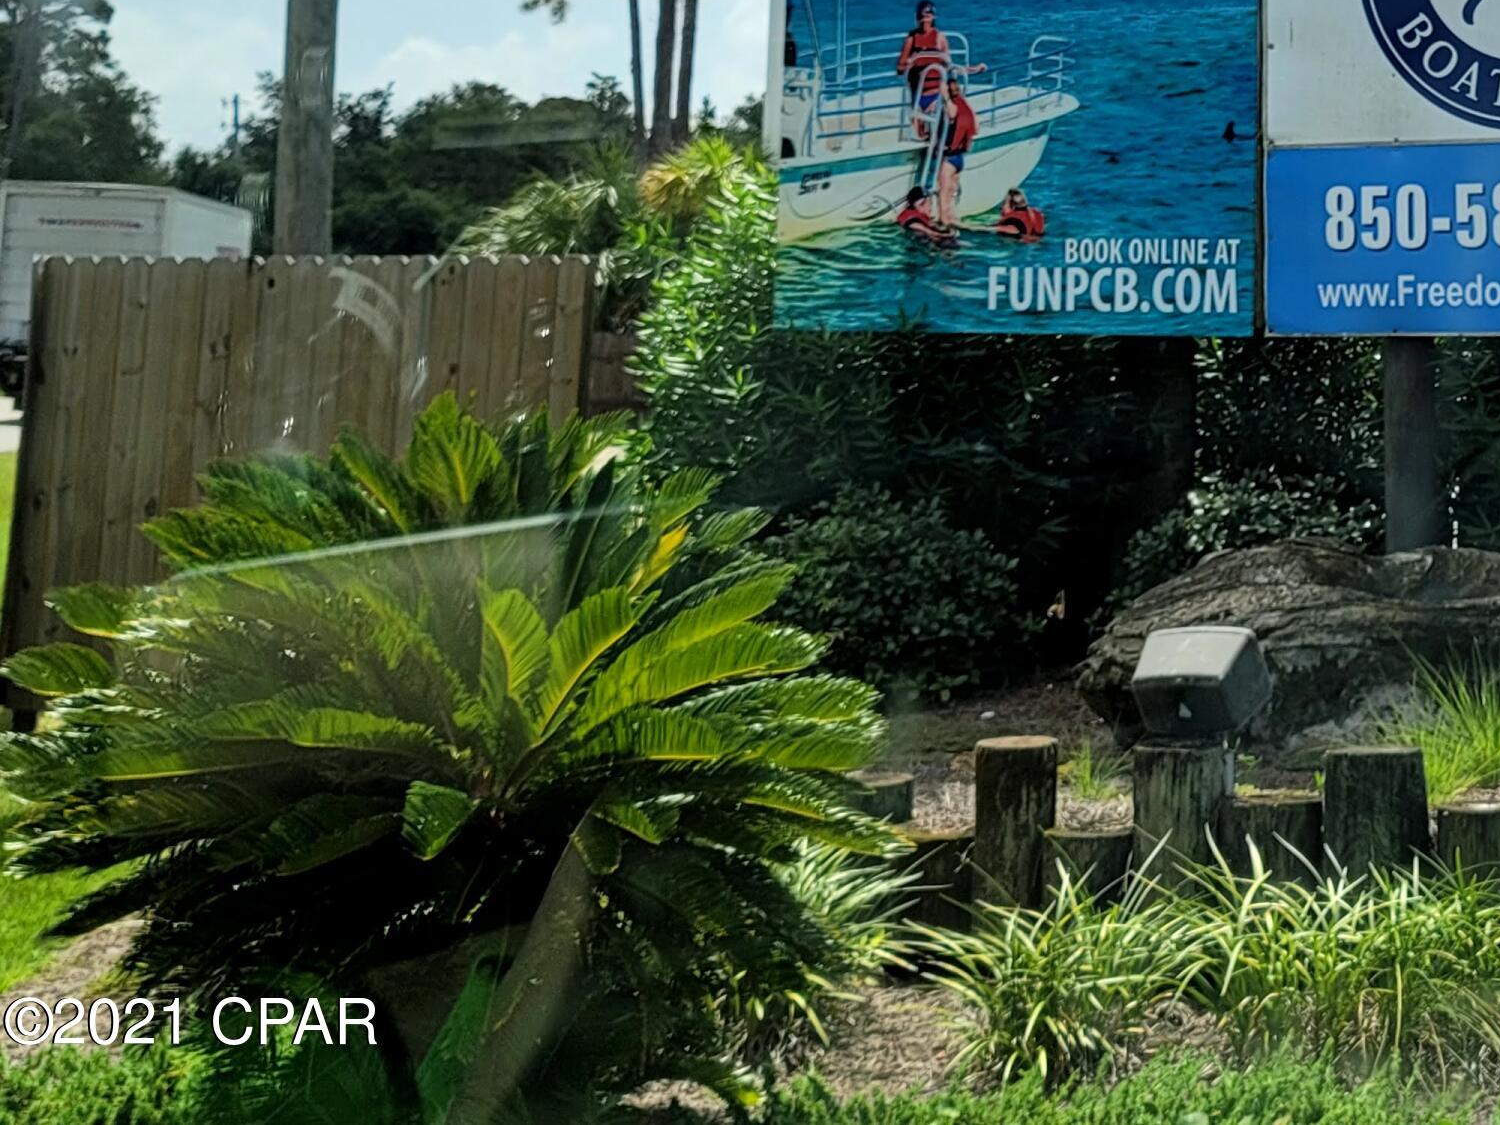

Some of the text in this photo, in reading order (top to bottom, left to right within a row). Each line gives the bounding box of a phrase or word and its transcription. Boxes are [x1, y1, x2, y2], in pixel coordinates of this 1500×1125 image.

[1064, 237, 1241, 265] BOOK ONLINE AT
[987, 266, 1239, 314] FUNPCB.COM
